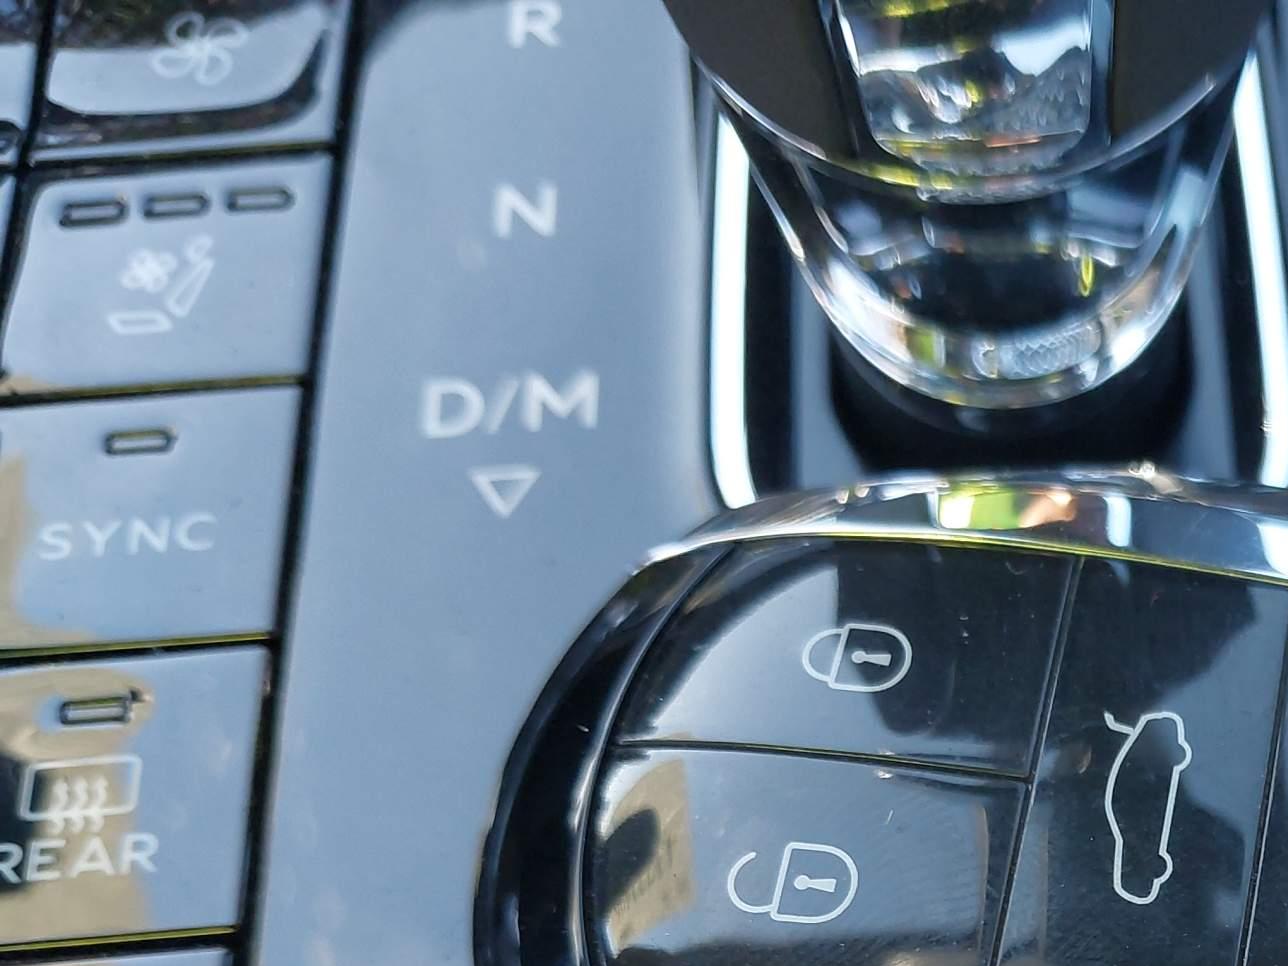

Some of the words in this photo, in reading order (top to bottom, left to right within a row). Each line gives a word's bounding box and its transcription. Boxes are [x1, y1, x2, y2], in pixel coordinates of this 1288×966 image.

[509, 0, 563, 48] R
[492, 183, 558, 238] N
[420, 369, 600, 439] D/M
[38, 512, 218, 562] SYNC
[0, 832, 160, 884] REAR
